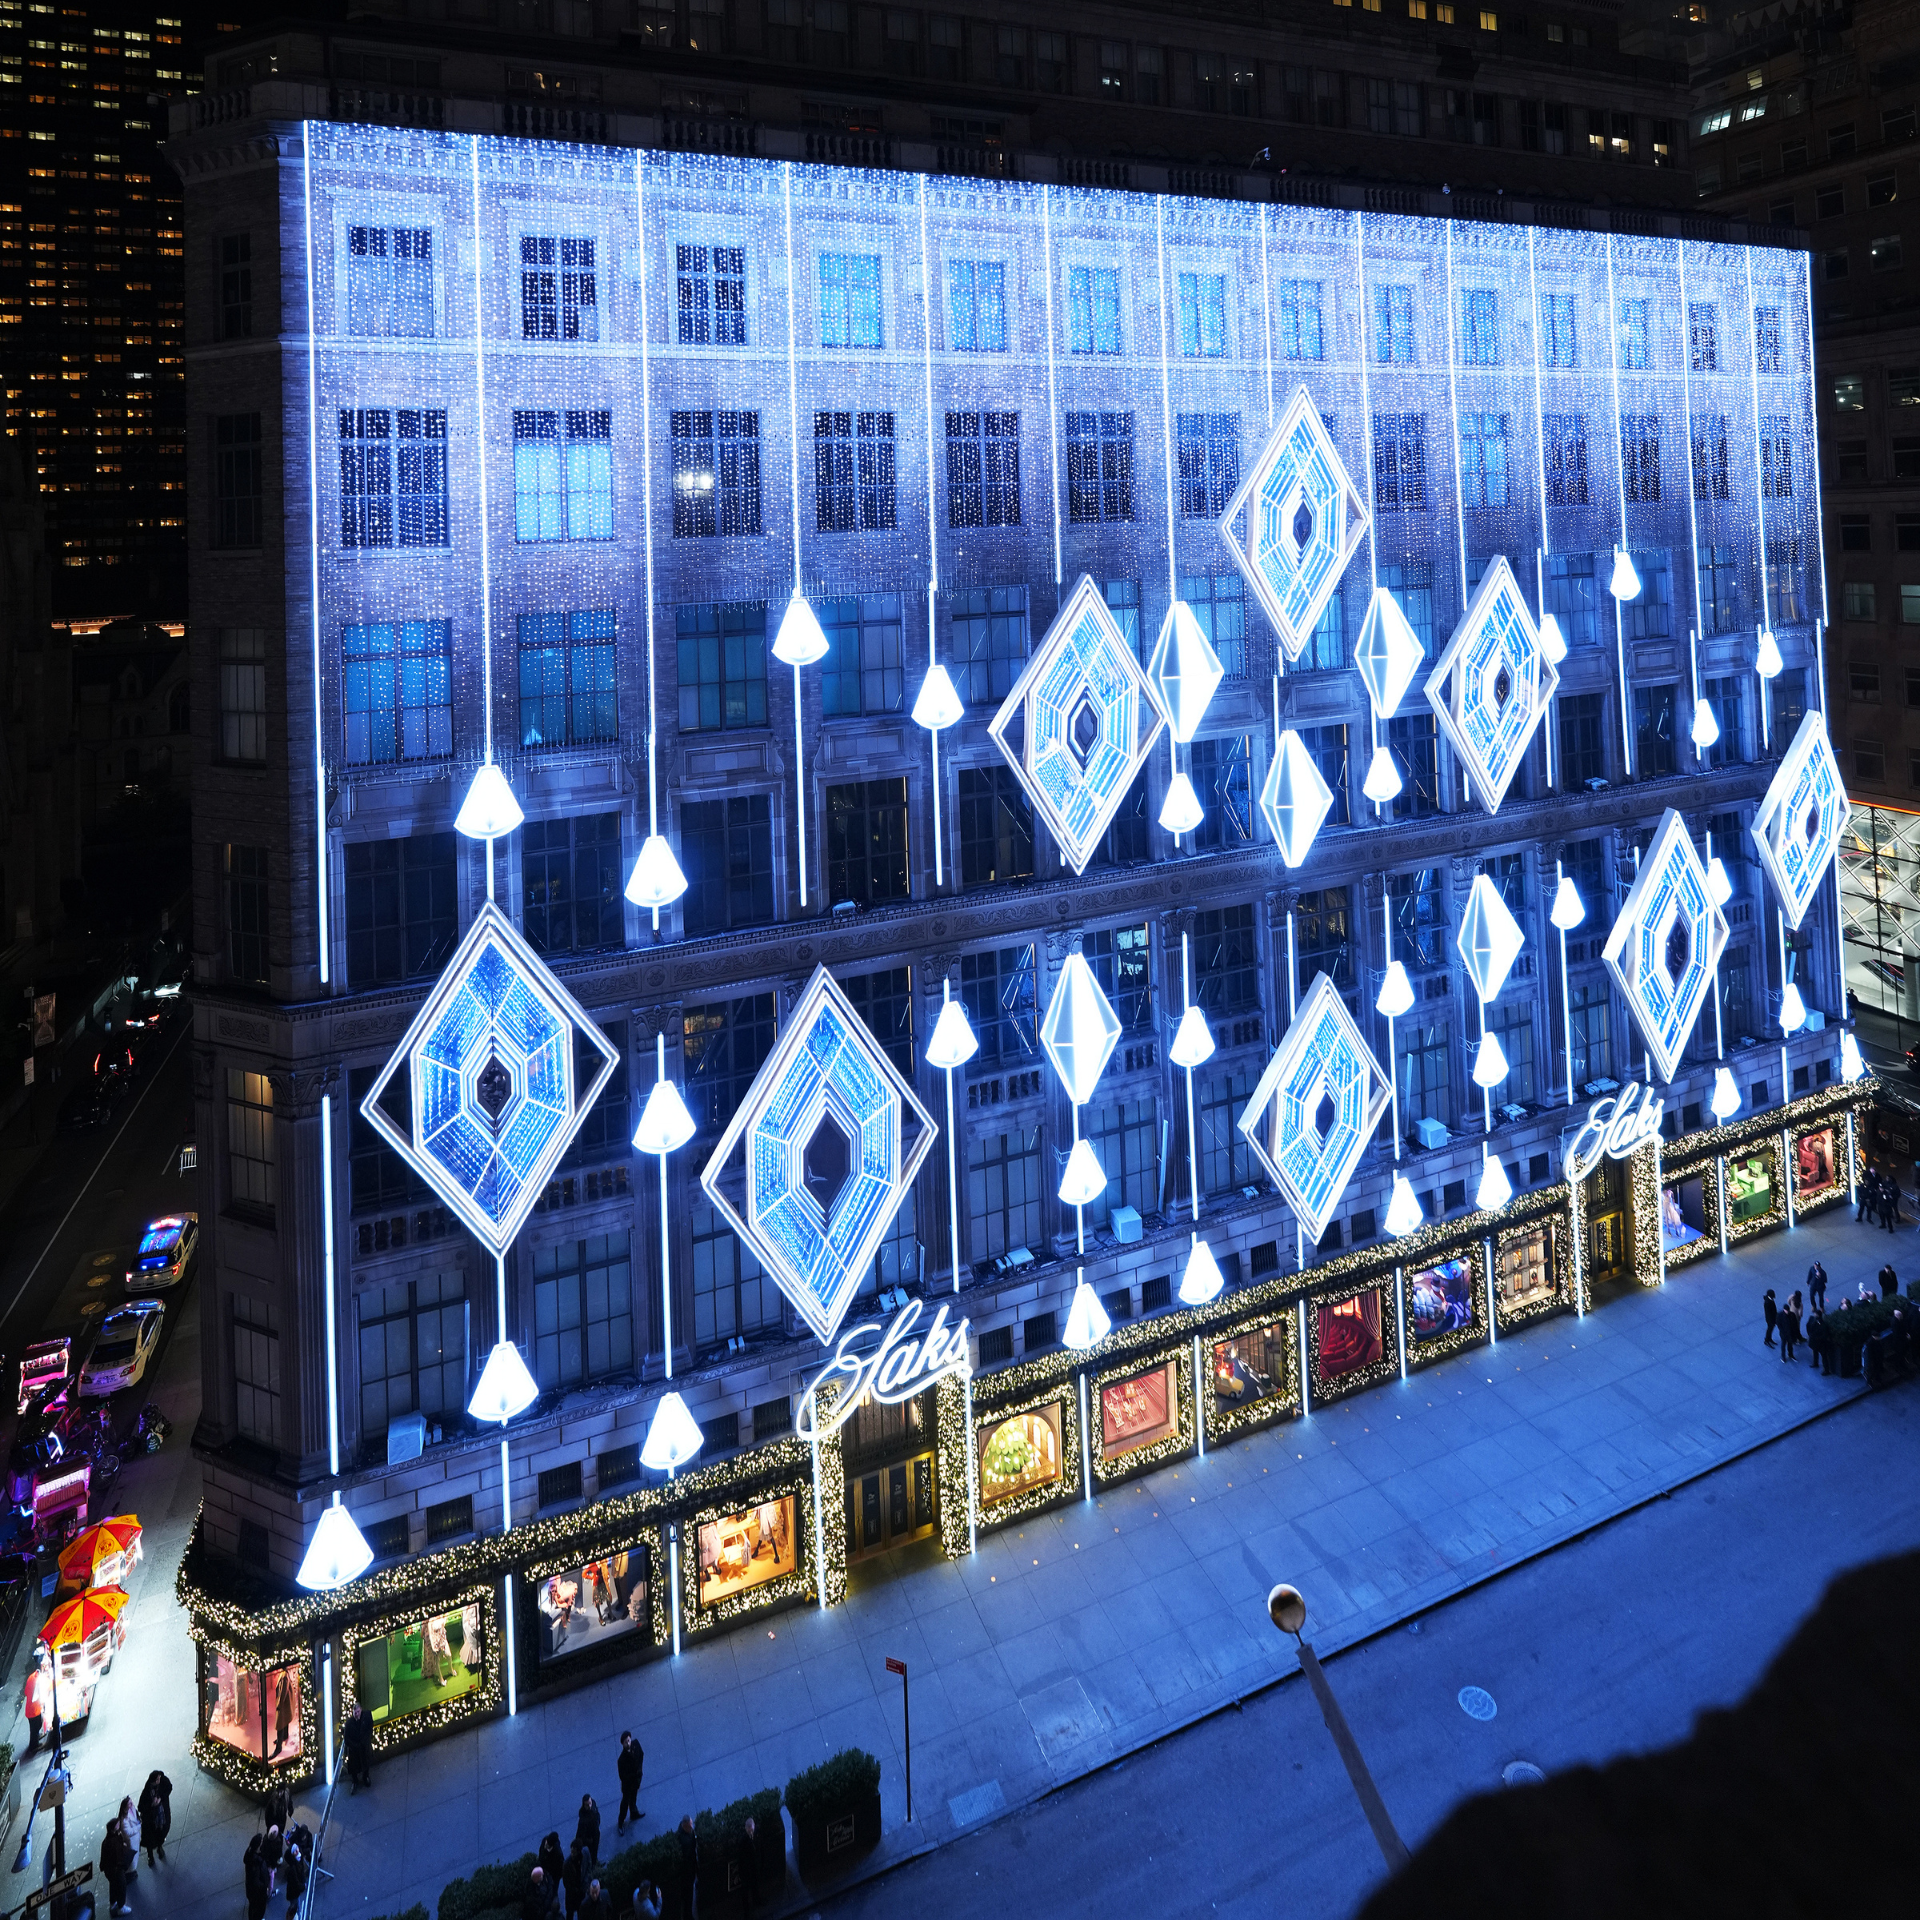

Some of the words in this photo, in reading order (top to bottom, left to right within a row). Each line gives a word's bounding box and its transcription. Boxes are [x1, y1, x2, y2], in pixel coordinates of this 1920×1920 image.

[1565, 1082, 1665, 1182] Saks
[796, 1297, 973, 1441] Saks
[63, 1871, 83, 1888] WAY
